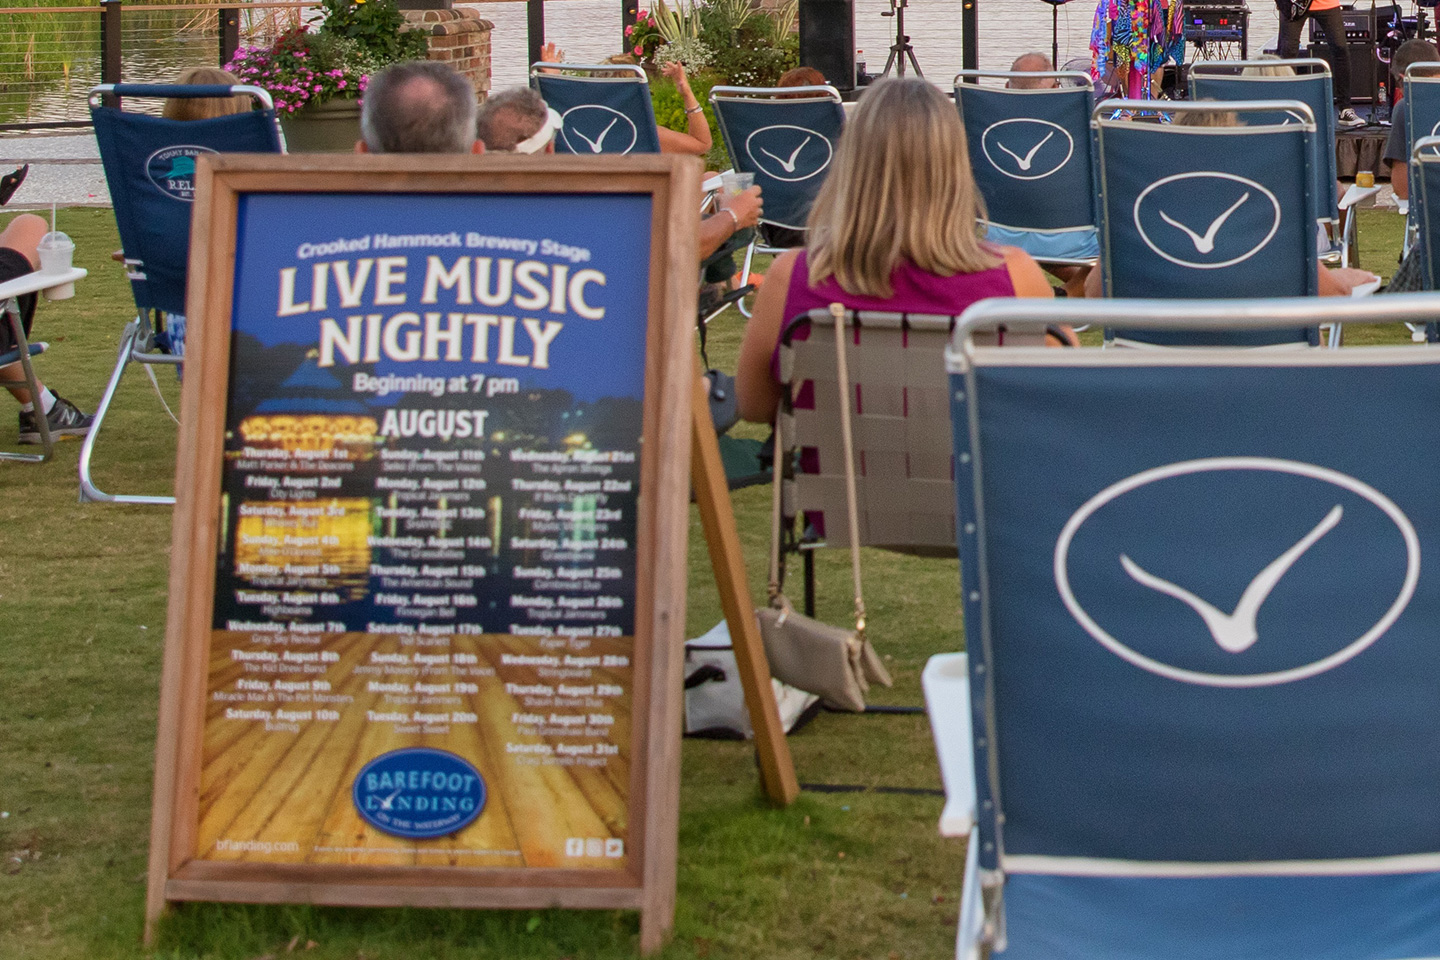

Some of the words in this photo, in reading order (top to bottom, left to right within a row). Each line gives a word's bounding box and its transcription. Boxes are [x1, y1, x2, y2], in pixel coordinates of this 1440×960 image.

[158, 150, 182, 161] TOMMY
[168, 180, 194, 190] REL
[298, 236, 370, 258] Crooked
[374, 232, 462, 249] Hammock
[466, 232, 538, 256] Brewery
[541, 239, 591, 262] Stage
[277, 256, 408, 317] LIVE
[420, 255, 606, 320] MUSIC
[318, 312, 564, 369] NIGHTLY
[353, 372, 446, 396] Beginning
[449, 376, 468, 392] at
[472, 375, 485, 392] 7
[487, 378, 519, 398] pm
[380, 409, 489, 438] AUGUST
[294, 448, 330, 460] August
[423, 448, 459, 460] August
[282, 476, 319, 490] August
[422, 477, 459, 490] August
[564, 480, 600, 492] August
[288, 506, 324, 518] August
[422, 506, 458, 519] August
[556, 508, 595, 521] August
[428, 536, 464, 548] August
[561, 538, 599, 550] August
[284, 564, 320, 576] August
[422, 564, 458, 578] August
[556, 566, 594, 580] August
[282, 592, 318, 604] August
[413, 593, 450, 606] August
[557, 596, 594, 609] August
[289, 621, 325, 634] August
[418, 622, 455, 636] August
[556, 624, 594, 638] August
[282, 651, 318, 663] August
[414, 652, 450, 666] August
[564, 654, 600, 668] August
[274, 680, 310, 692] August
[414, 682, 450, 695] August
[558, 684, 594, 697] August
[276, 709, 312, 722] August
[413, 711, 450, 724] August
[550, 714, 586, 728] August
[556, 744, 594, 756] August
[366, 770, 476, 792] BAREFOOT
[216, 839, 299, 854] bflanding.com
